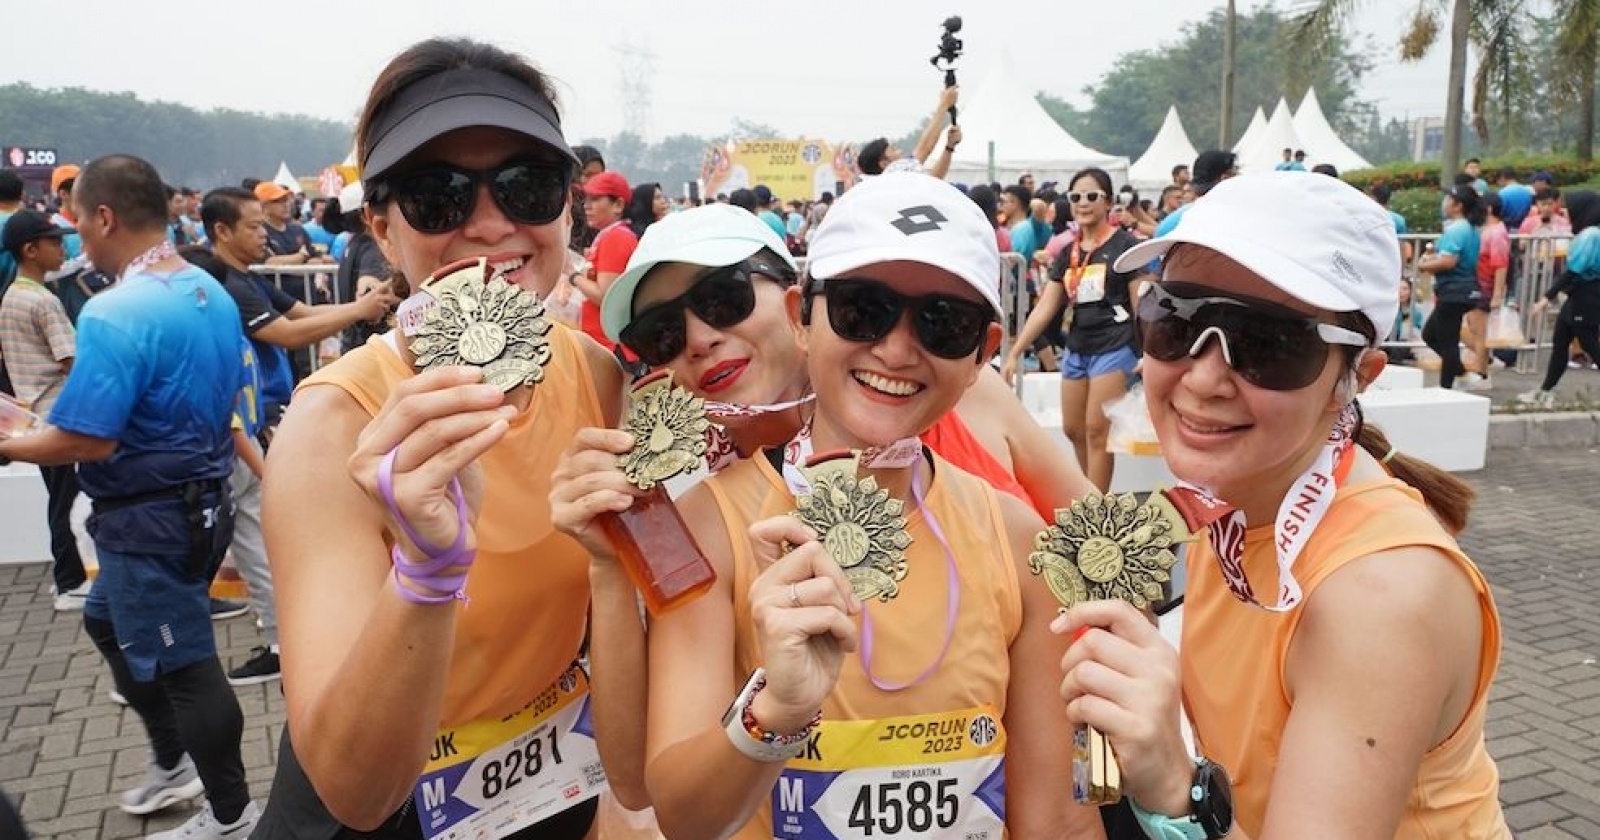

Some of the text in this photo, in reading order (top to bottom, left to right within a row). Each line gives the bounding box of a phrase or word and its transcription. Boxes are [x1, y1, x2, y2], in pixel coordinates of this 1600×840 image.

[769, 154, 795, 166] 2023
[533, 691, 559, 718] 2023
[878, 717, 967, 741] JCORUN
[922, 736, 964, 754] 2023
[482, 725, 562, 800] 8281
[422, 776, 446, 812] M
[779, 776, 804, 813] M
[848, 777, 959, 836] 4585
